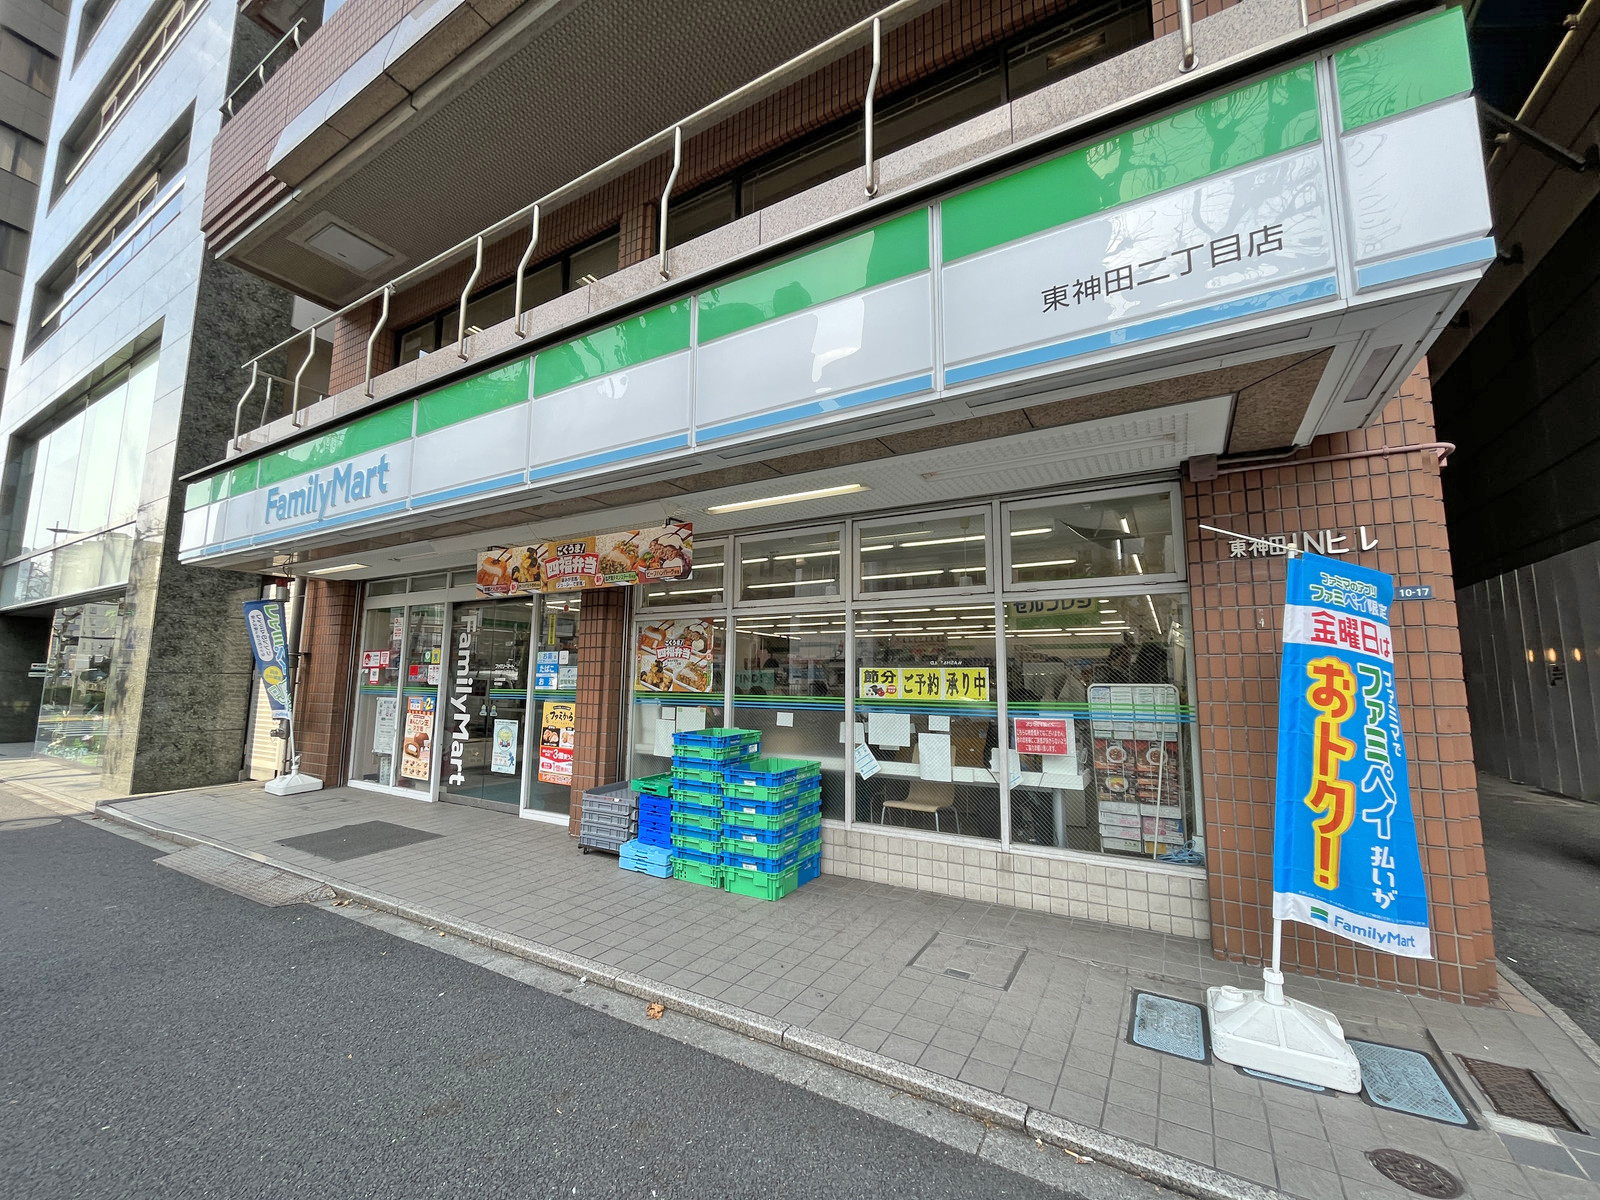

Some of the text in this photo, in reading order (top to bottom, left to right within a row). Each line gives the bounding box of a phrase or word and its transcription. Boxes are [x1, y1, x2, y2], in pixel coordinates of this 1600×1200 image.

[1041, 223, 1284, 314] 東神田二丁目店
[264, 453, 389, 525] FamilyMart
[546, 556, 597, 577] 四福弁当
[1319, 571, 1377, 599] ファミマのアプリ
[1399, 587, 1430, 598] 10-17
[1310, 610, 1391, 658] 金曜日は
[863, 670, 896, 684] 節分
[449, 615, 477, 786] FamilyMart
[1308, 660, 1352, 888] おトク!
[1333, 914, 1416, 948] FamilyMart
